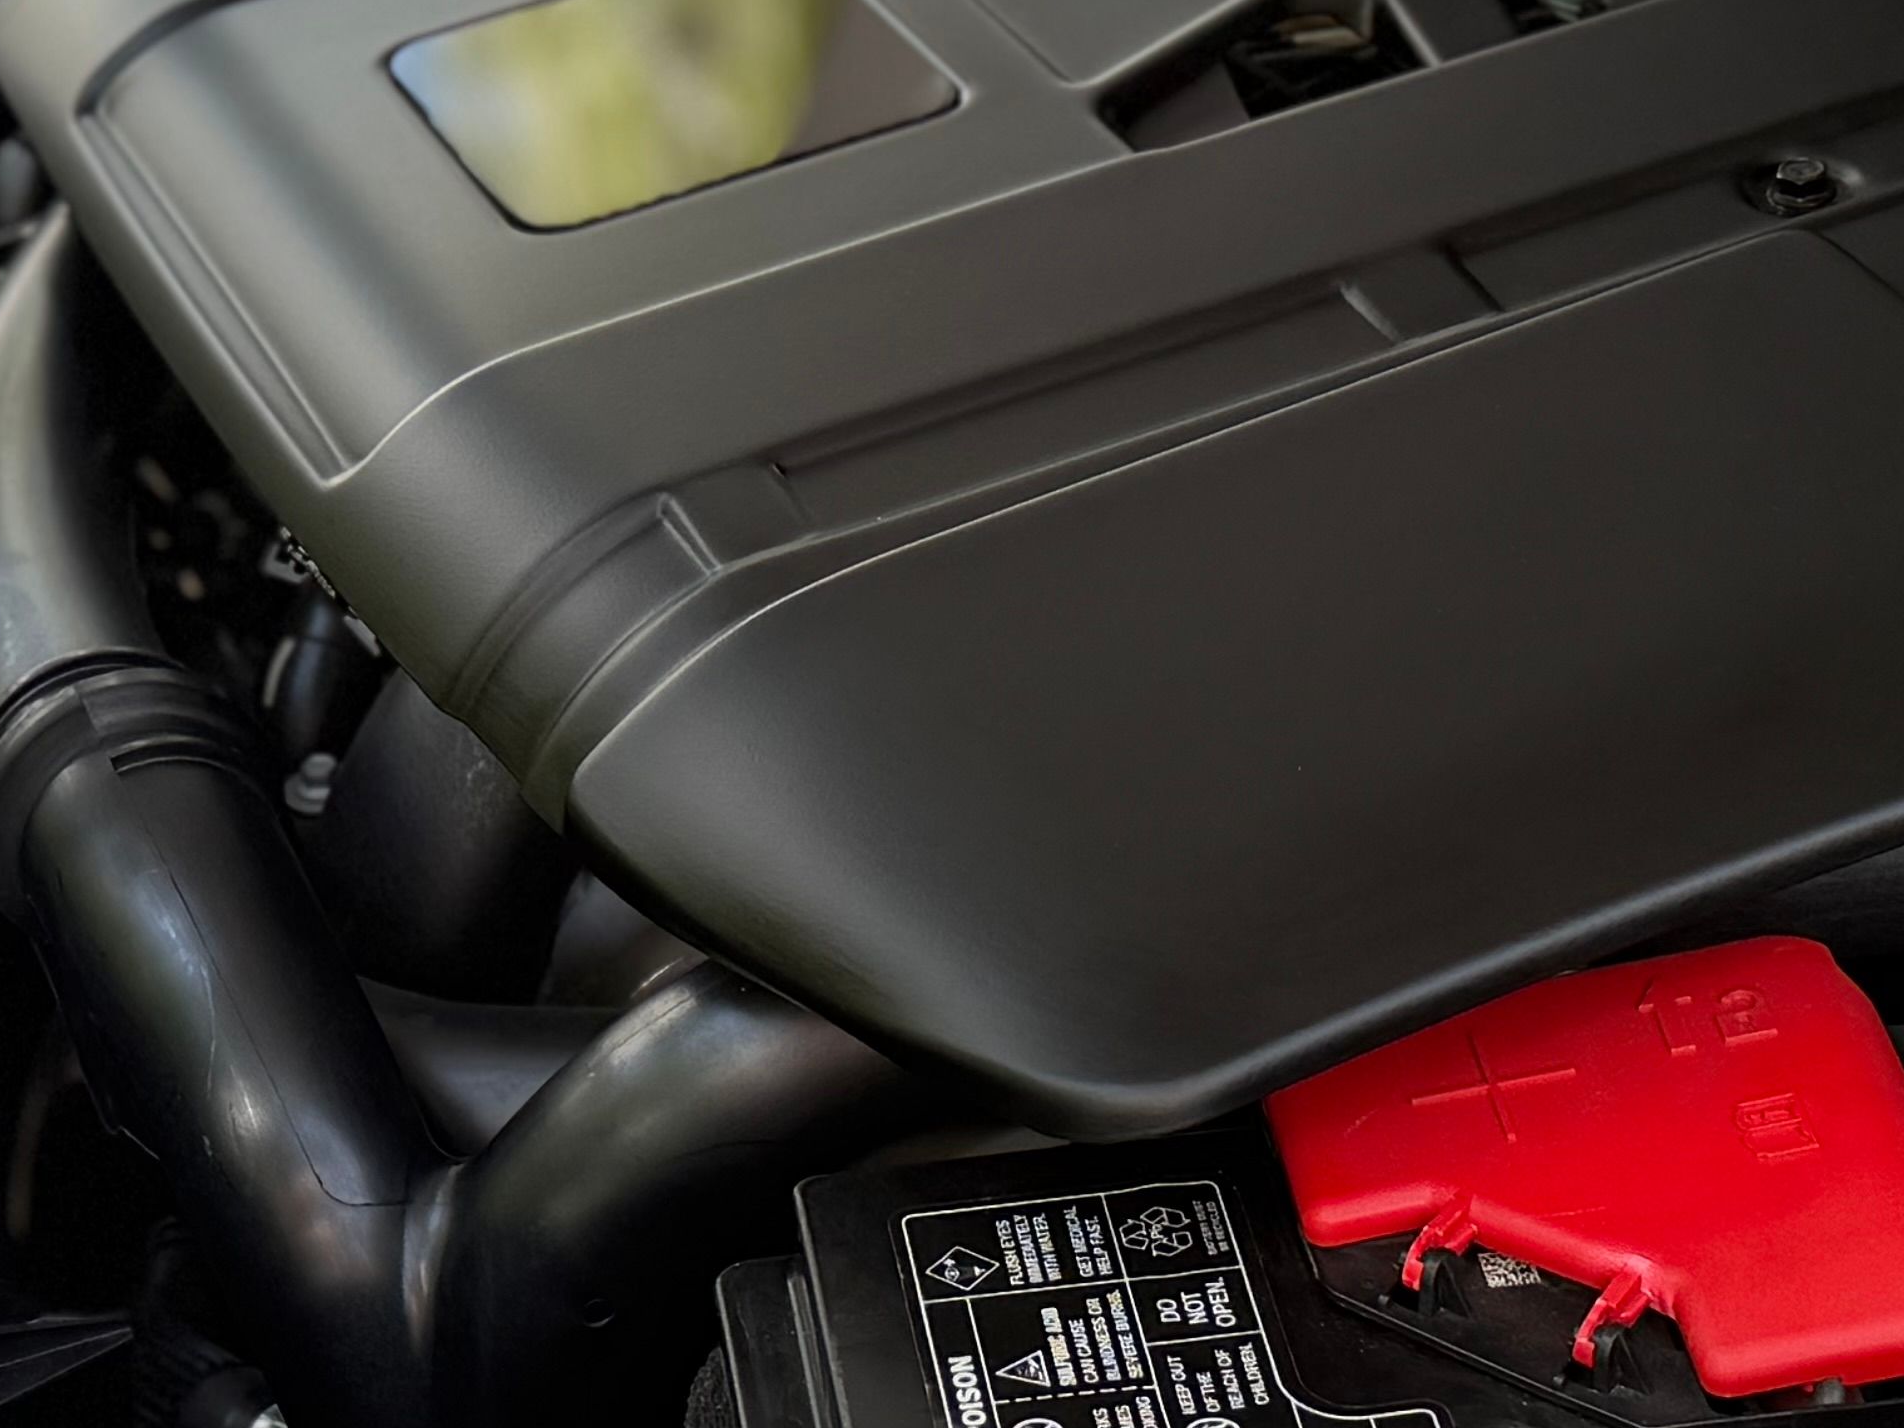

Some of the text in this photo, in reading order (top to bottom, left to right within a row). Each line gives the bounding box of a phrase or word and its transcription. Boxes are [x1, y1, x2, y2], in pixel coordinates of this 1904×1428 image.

[996, 1220, 1025, 1285] FLUSH EYES
[1063, 1205, 1094, 1277] GET MEDICAL
[1085, 1215, 1113, 1275] HELP FAST.
[1156, 1298, 1181, 1323] DO
[1180, 1291, 1209, 1325] NOT
[1204, 1276, 1236, 1328] OPEN.
[1068, 1318, 1099, 1383] CAN CAUSE
[1085, 1297, 1122, 1381] BLINDNESS OR
[1118, 1332, 1144, 1379] SEVERE
[1167, 1355, 1197, 1415] KEEP OUT
[1214, 1348, 1246, 1410] REACH OF
